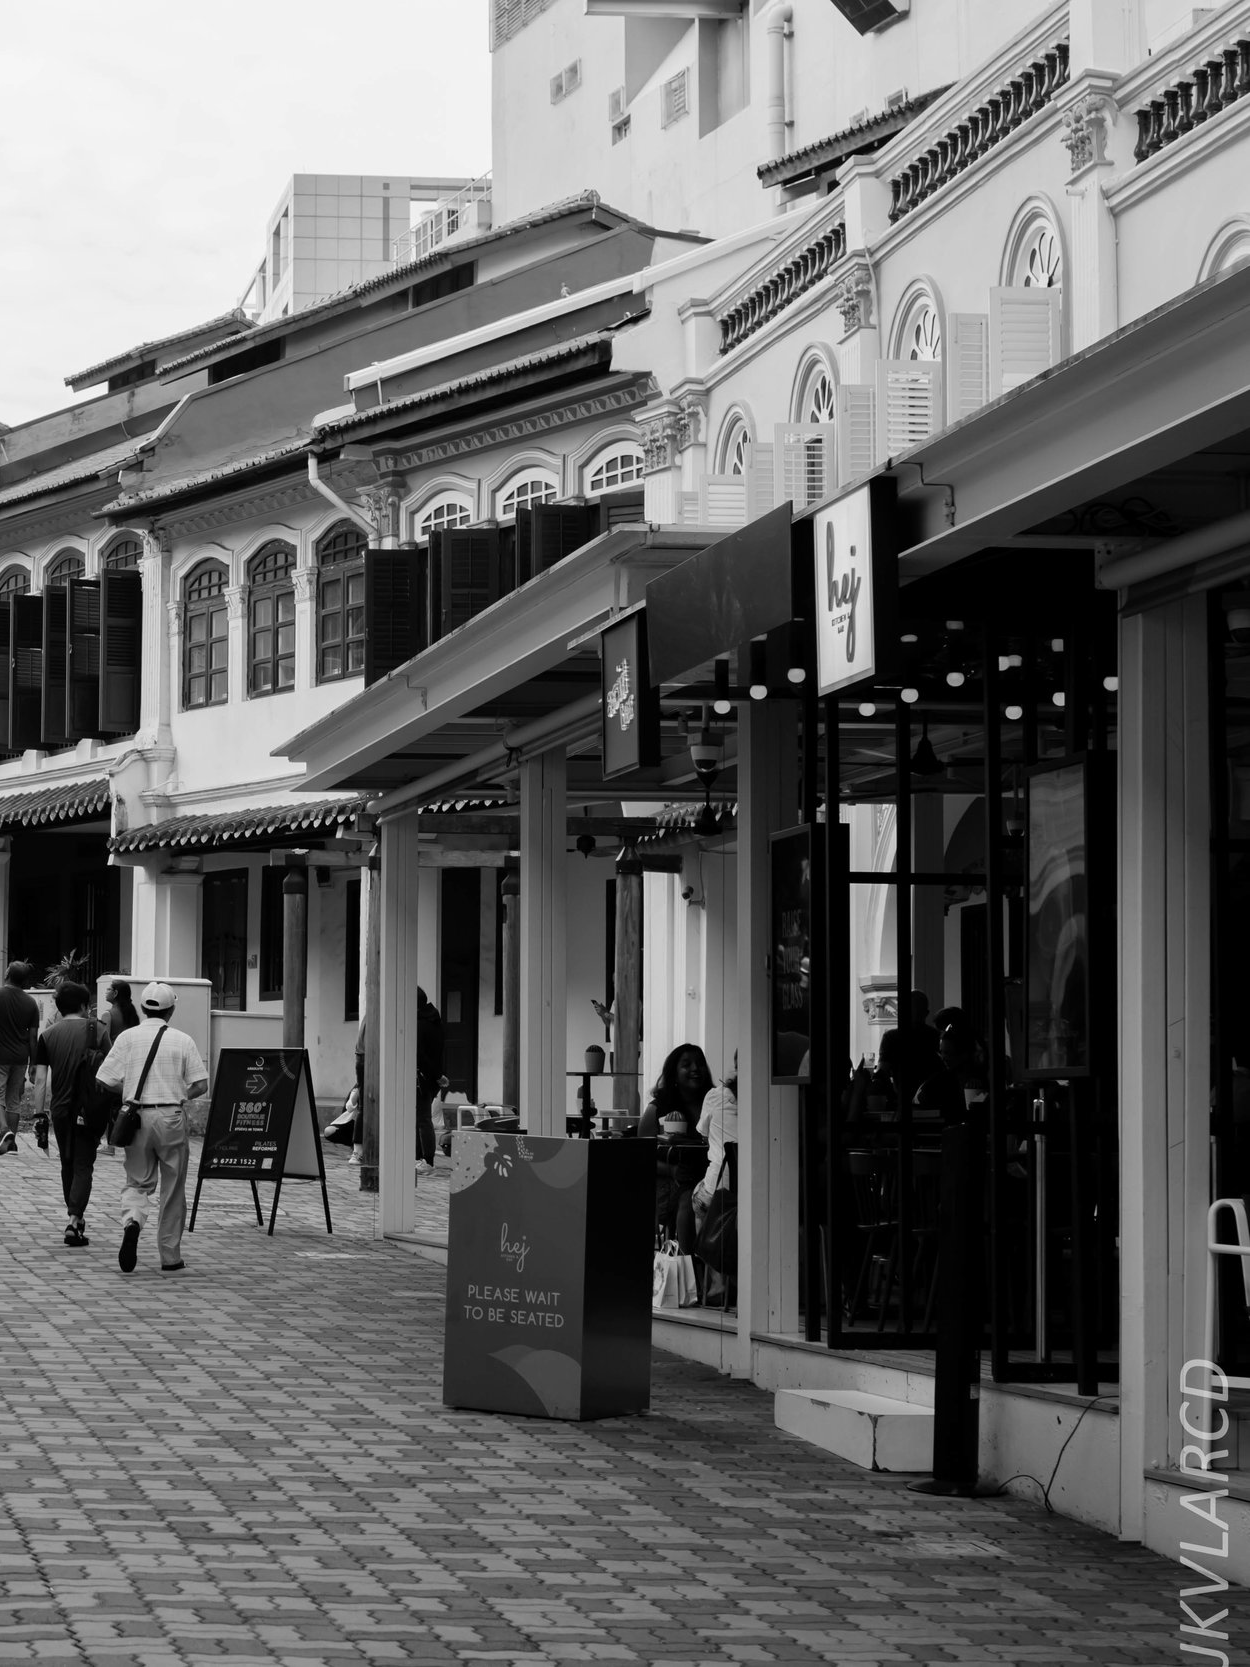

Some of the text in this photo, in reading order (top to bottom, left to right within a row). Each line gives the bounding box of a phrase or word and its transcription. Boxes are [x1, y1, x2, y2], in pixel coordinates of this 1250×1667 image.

[782, 982, 803, 1009] GLASS
[500, 1222, 530, 1272] hej
[468, 1284, 561, 1306] PLEASE WAIT
[463, 1305, 565, 1328] TO BE SEATED
